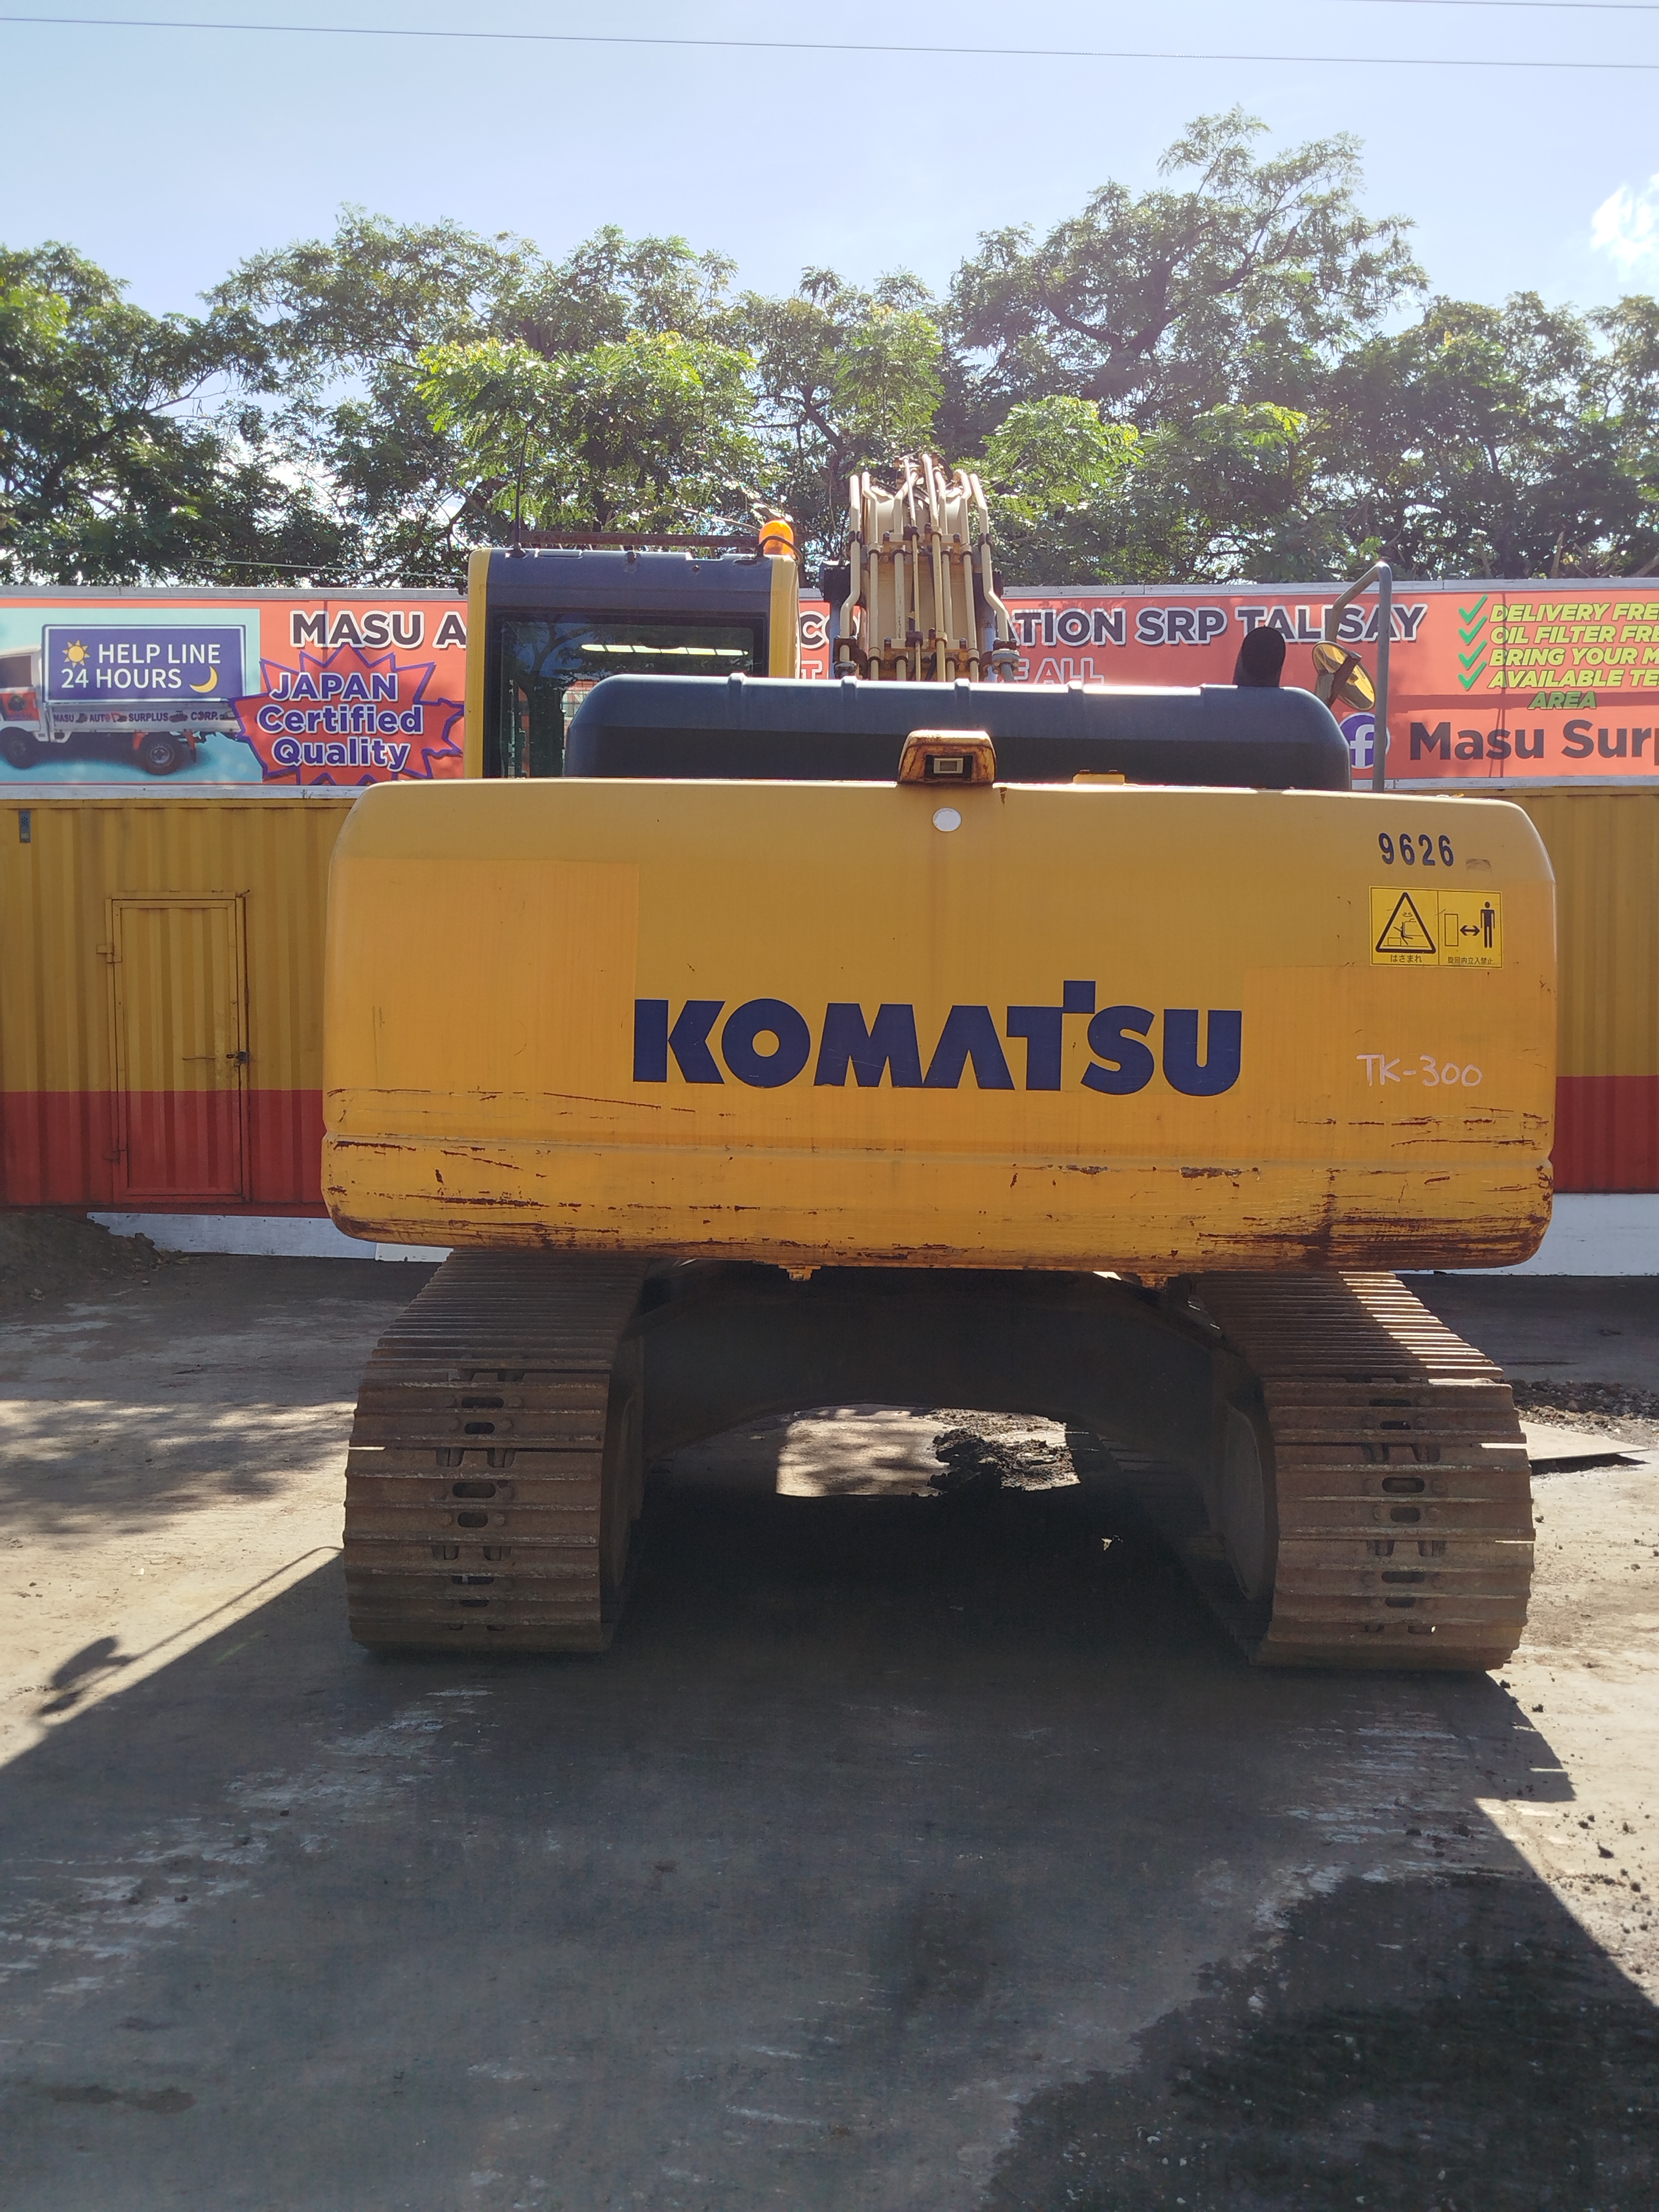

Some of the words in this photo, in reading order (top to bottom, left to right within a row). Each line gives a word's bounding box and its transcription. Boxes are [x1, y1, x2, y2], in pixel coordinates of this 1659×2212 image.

[1489, 603, 1611, 622] DELIVERY
[290, 611, 424, 648] MASU
[1135, 607, 1228, 644] SRP
[1490, 625, 1530, 644] OIL
[1534, 625, 1616, 644] FILTER
[98, 644, 160, 664] HELP
[168, 644, 221, 664] LINE
[1489, 648, 1566, 666] BRING
[1572, 647, 1639, 665] YOUR
[61, 668, 89, 688] 24
[96, 668, 182, 688] HOURS
[269, 672, 398, 701] JAPAN
[1487, 669, 1625, 688] AVAILABLE
[1629, 669, 1659, 687] TE
[1527, 691, 1597, 709] AREA
[54, 713, 74, 722] MASU
[128, 713, 169, 722] SURPLUS
[257, 704, 424, 734] Certified
[1410, 722, 1545, 760] Masu
[1561, 719, 1659, 766] Sur
[272, 736, 411, 771] Quality
[1378, 832, 1454, 867] 9626
[1390, 954, 1422, 963] はさまれ
[633, 980, 1242, 1096] KOMATSU
[1356, 1054, 1483, 1087] TK-300
